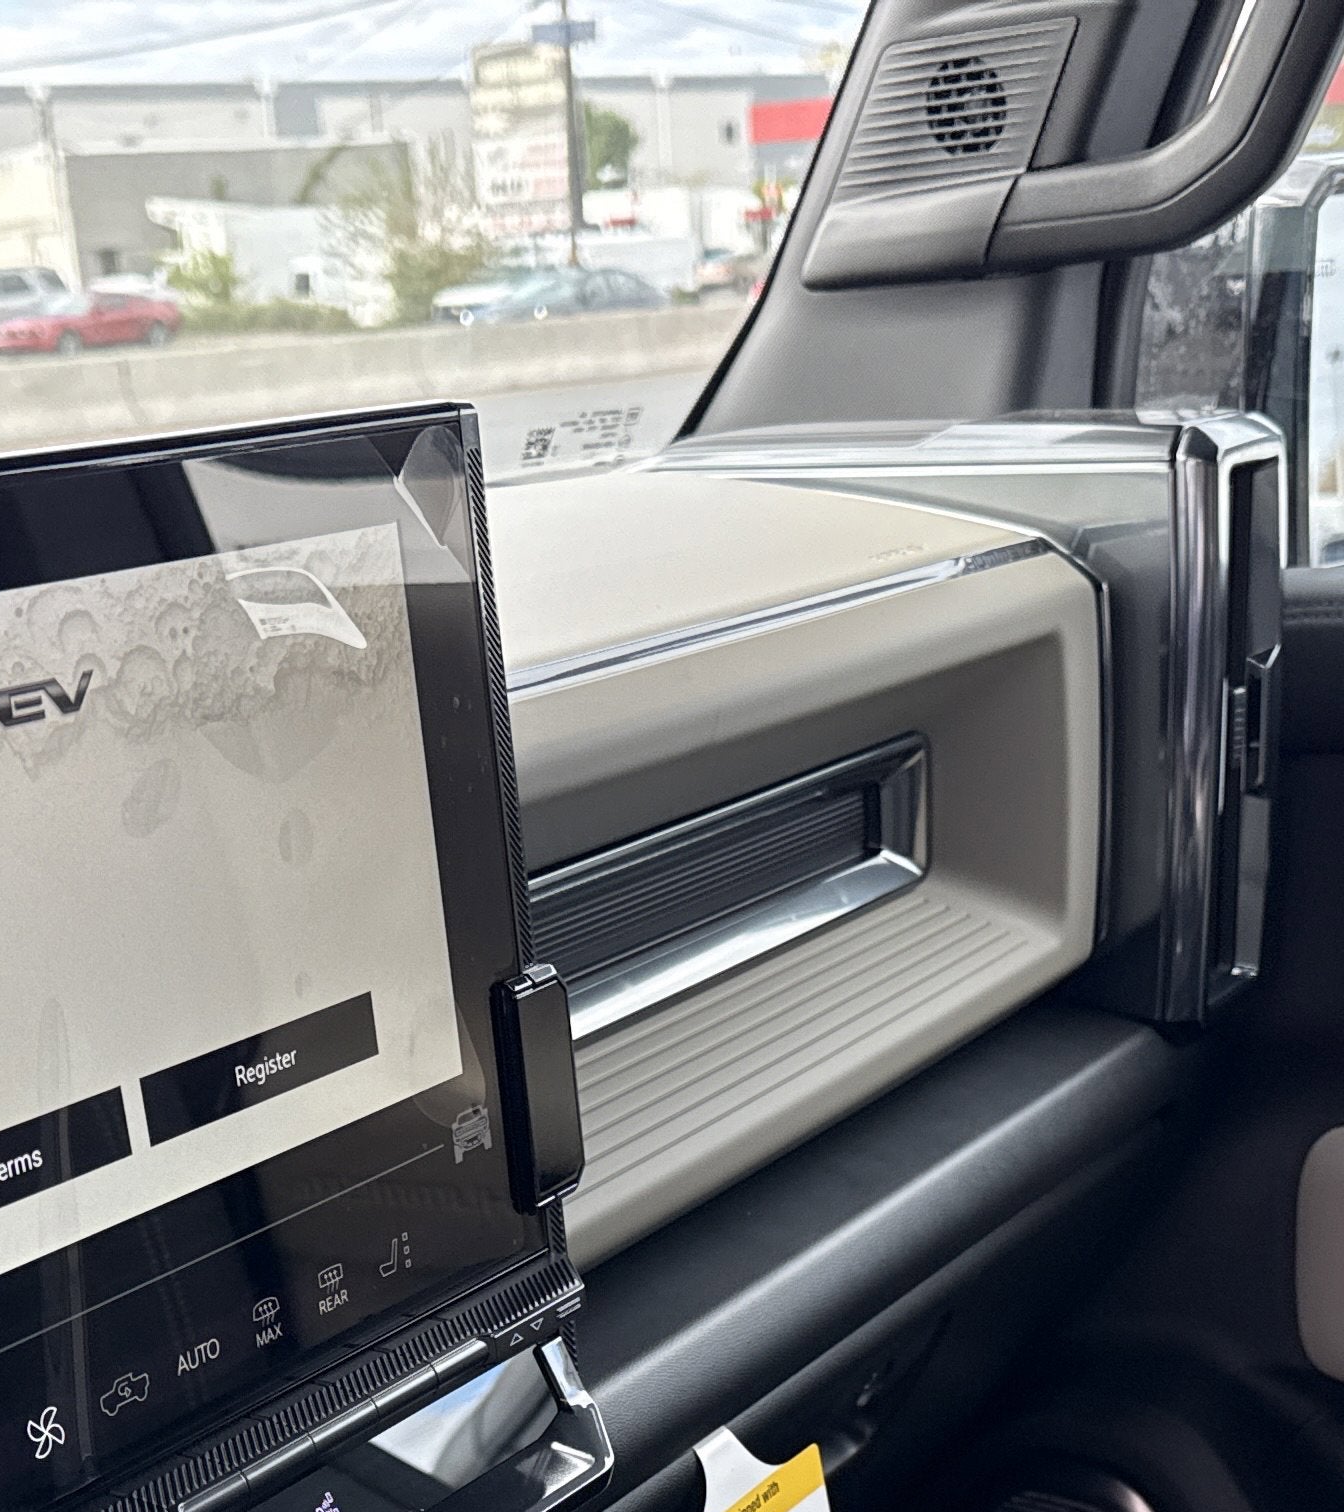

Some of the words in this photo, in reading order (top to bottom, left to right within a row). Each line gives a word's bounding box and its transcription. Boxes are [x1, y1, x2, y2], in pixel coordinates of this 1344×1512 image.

[235, 1050, 296, 1086] Register
[319, 1290, 348, 1315] REAR
[256, 1323, 282, 1347] MAX
[178, 1339, 219, 1376] AUTO
[762, 1482, 779, 1503] with
